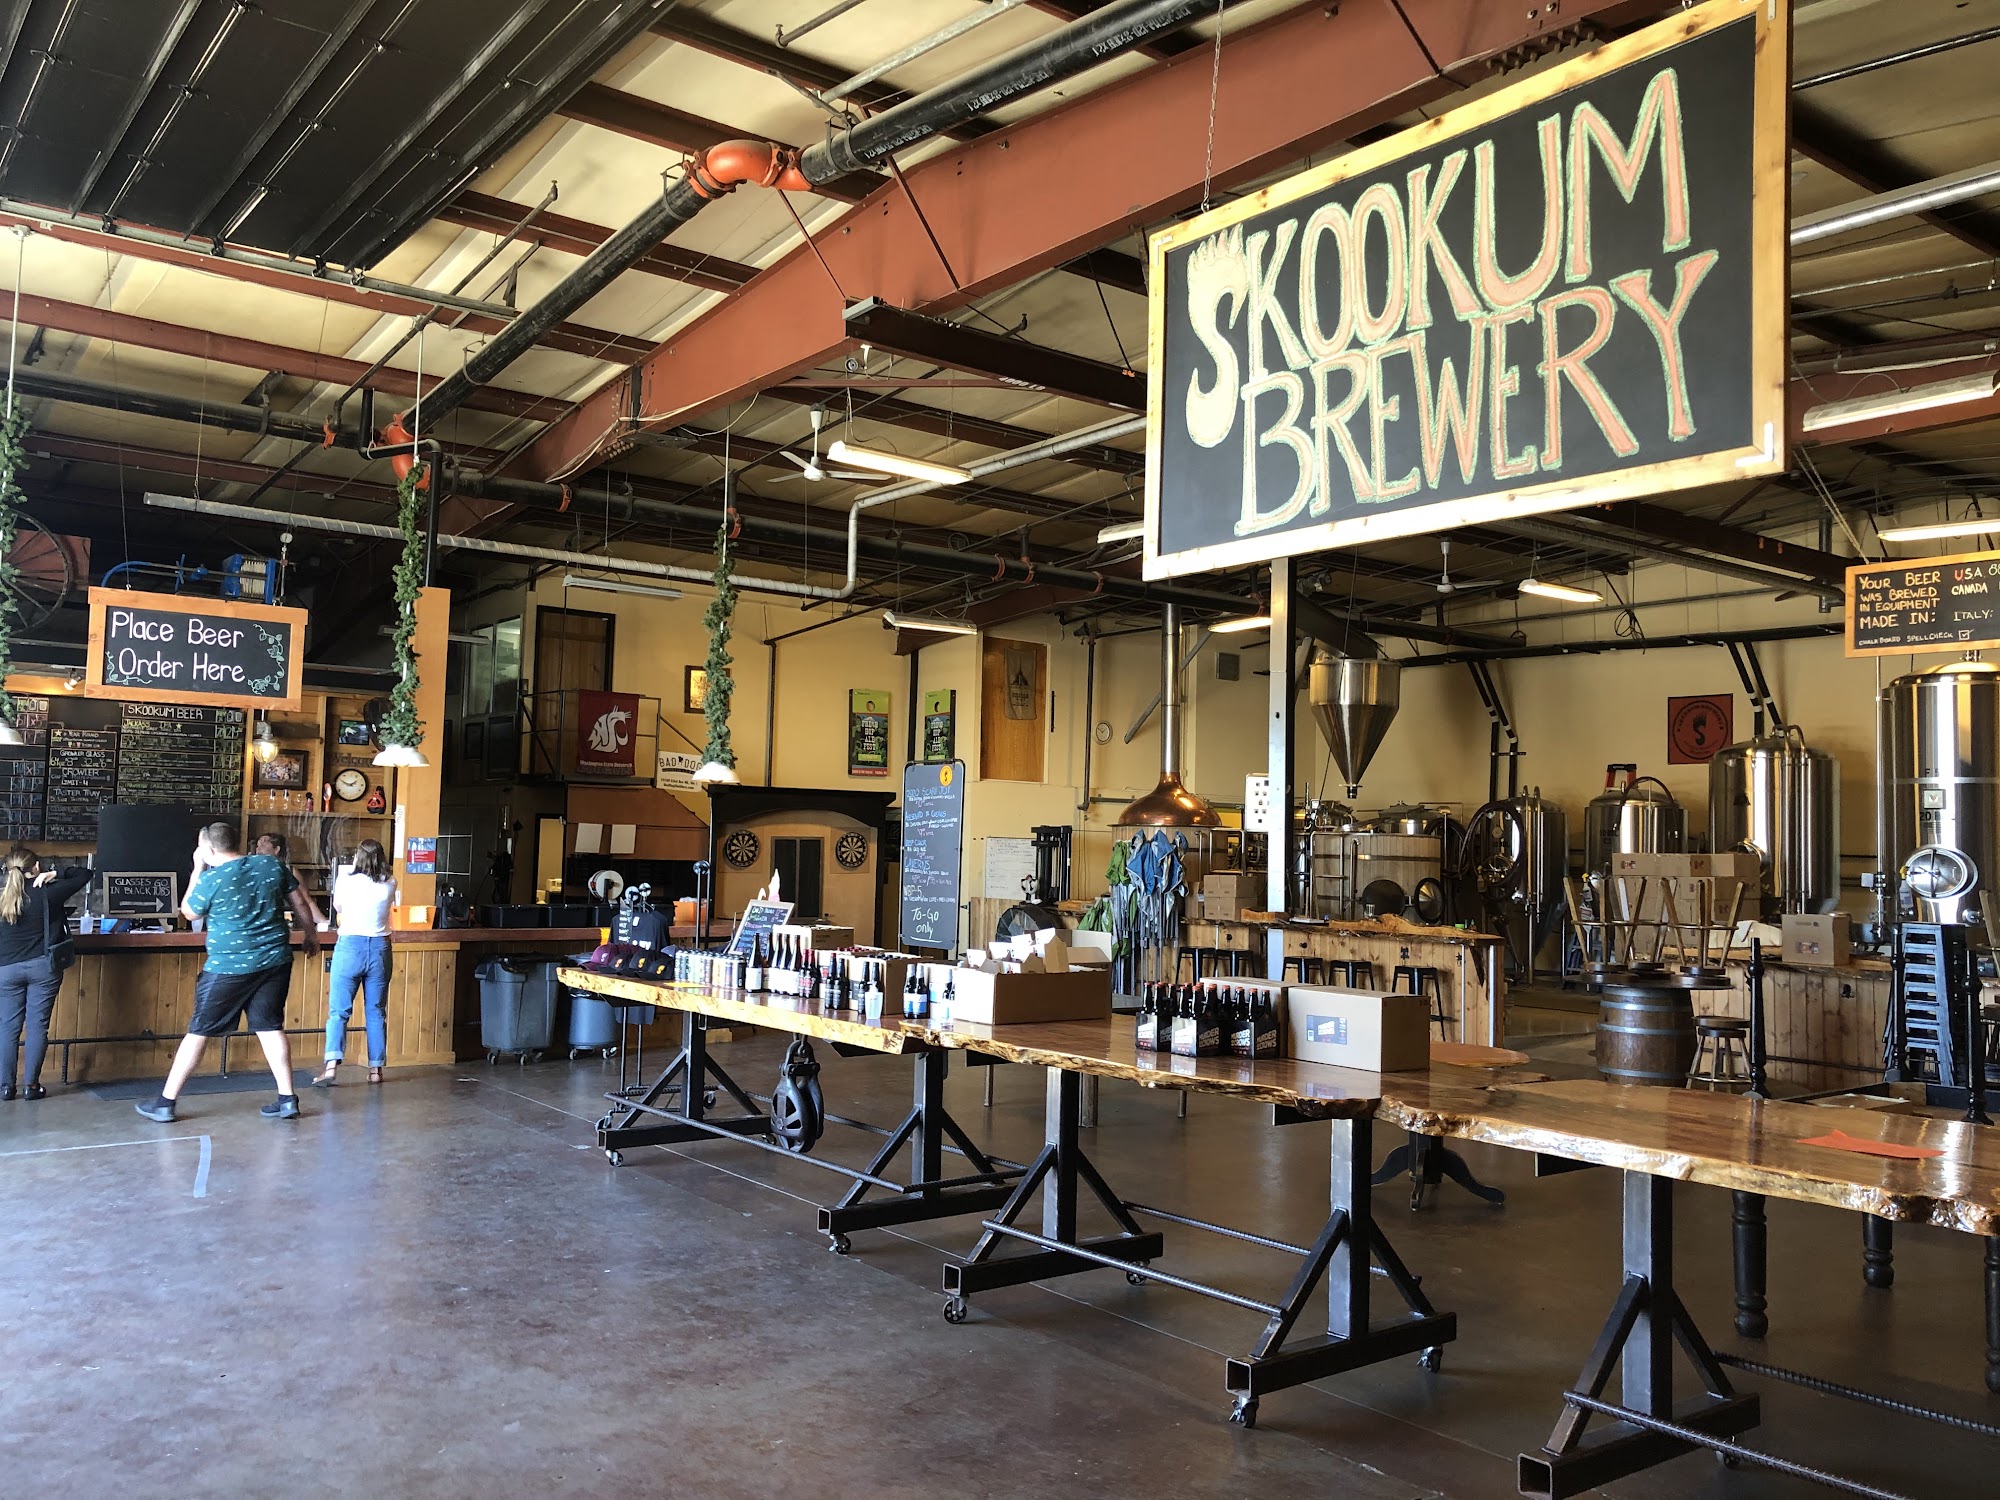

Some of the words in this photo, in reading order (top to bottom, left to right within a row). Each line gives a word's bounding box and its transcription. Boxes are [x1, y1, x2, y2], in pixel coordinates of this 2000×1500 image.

[1185, 67, 1691, 448] SKOOKUM
[1234, 249, 1719, 537] BREWERY
[1859, 576, 1891, 590] YOUR
[1905, 571, 1941, 587] BEER
[1860, 592, 1882, 602] WAS
[1889, 587, 1937, 600] BREWED
[1951, 582, 1988, 596] CANADA
[1860, 603, 1870, 612] IN
[1875, 598, 1940, 612] EQUIPMENT
[1860, 614, 1899, 630] MADE
[1909, 611, 1936, 625] IN:
[111, 611, 174, 642] Place
[187, 618, 245, 648] Beer
[118, 648, 184, 680] Order
[193, 652, 246, 683] Here
[128, 704, 175, 718] SKOOKUM
[177, 708, 203, 720] BEER
[659, 757, 677, 767] BAD
[62, 768, 99, 776] CROWLER
[53, 788, 81, 796] TASTER
[83, 790, 101, 799] TRAY
[115, 878, 151, 886] GLASSES
[154, 879, 168, 887] GO
[124, 887, 151, 895] BLACK
[152, 886, 170, 896] TUBS
[911, 907, 939, 923] To-Go
[916, 921, 933, 939] only
